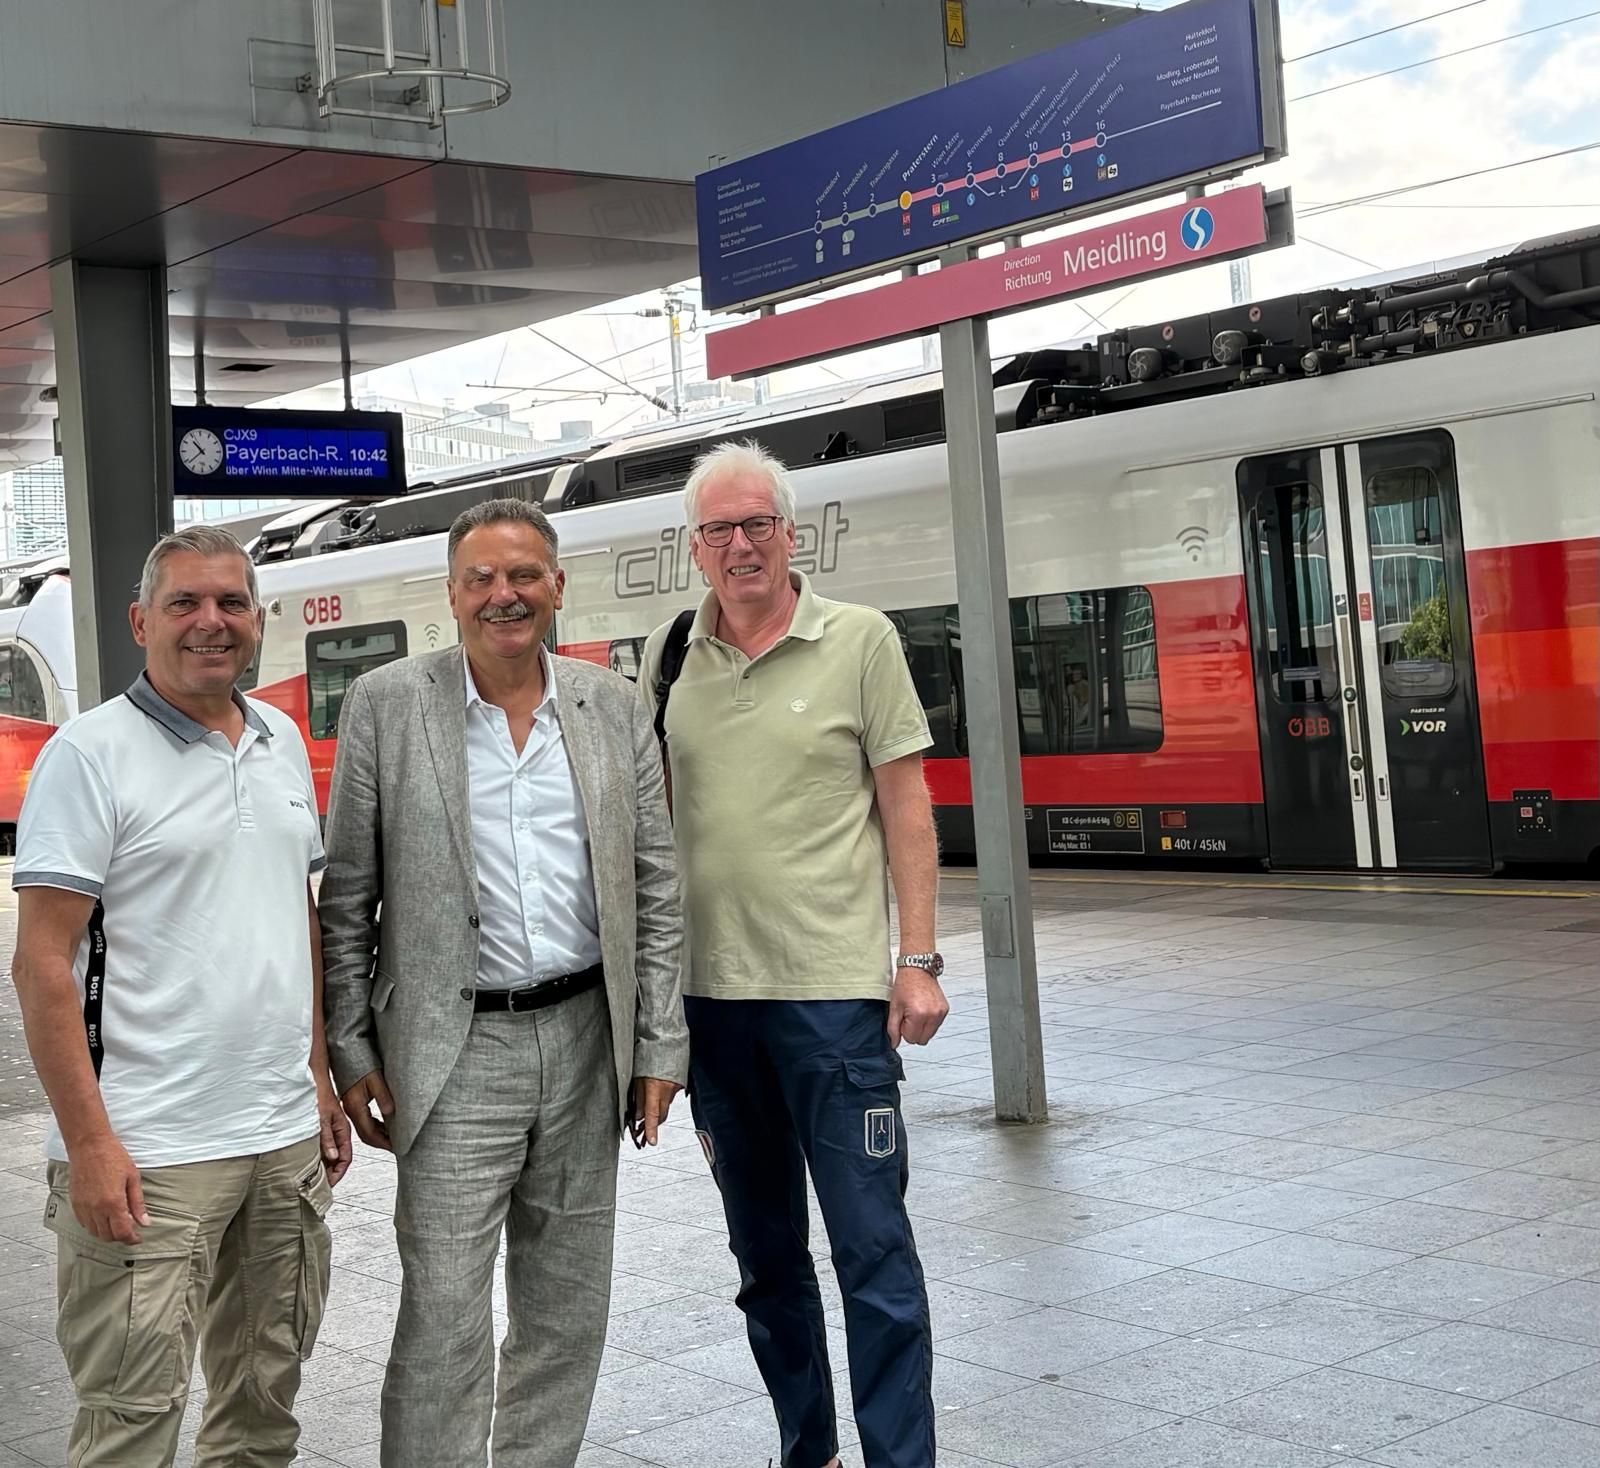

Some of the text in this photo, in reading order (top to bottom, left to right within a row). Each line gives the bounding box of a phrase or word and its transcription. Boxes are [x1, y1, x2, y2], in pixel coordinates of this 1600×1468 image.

[1095, 82, 1124, 117] Meidling
[1095, 120, 1106, 132] 16
[965, 124, 994, 158] Rennweg
[1061, 131, 1071, 142] 13
[1028, 141, 1039, 152] 10
[901, 133, 940, 182] Praterstern
[998, 152, 1004, 162] 8
[967, 162, 973, 172] 5
[841, 162, 869, 198] Handelskai
[931, 174, 937, 184] 3
[870, 193, 875, 203] 2
[842, 202, 848, 211] 3
[815, 210, 821, 219] 7
[1003, 253, 1041, 272] Direction
[1005, 270, 1052, 291] Richtung
[1063, 230, 1167, 276] Meidling
[223, 428, 258, 441] CJX9
[225, 444, 388, 464] Payerbach-R. 10:42
[226, 465, 249, 476] über
[303, 595, 342, 625] ÖBB
[1288, 717, 1330, 737] ÖBB
[1411, 720, 1447, 733] VOR
[1174, 838, 1227, 852] 40t / 45kN
[94, 929, 104, 954] BOSS
[89, 975, 100, 1001] BOSS
[88, 1023, 99, 1049] BOSS
